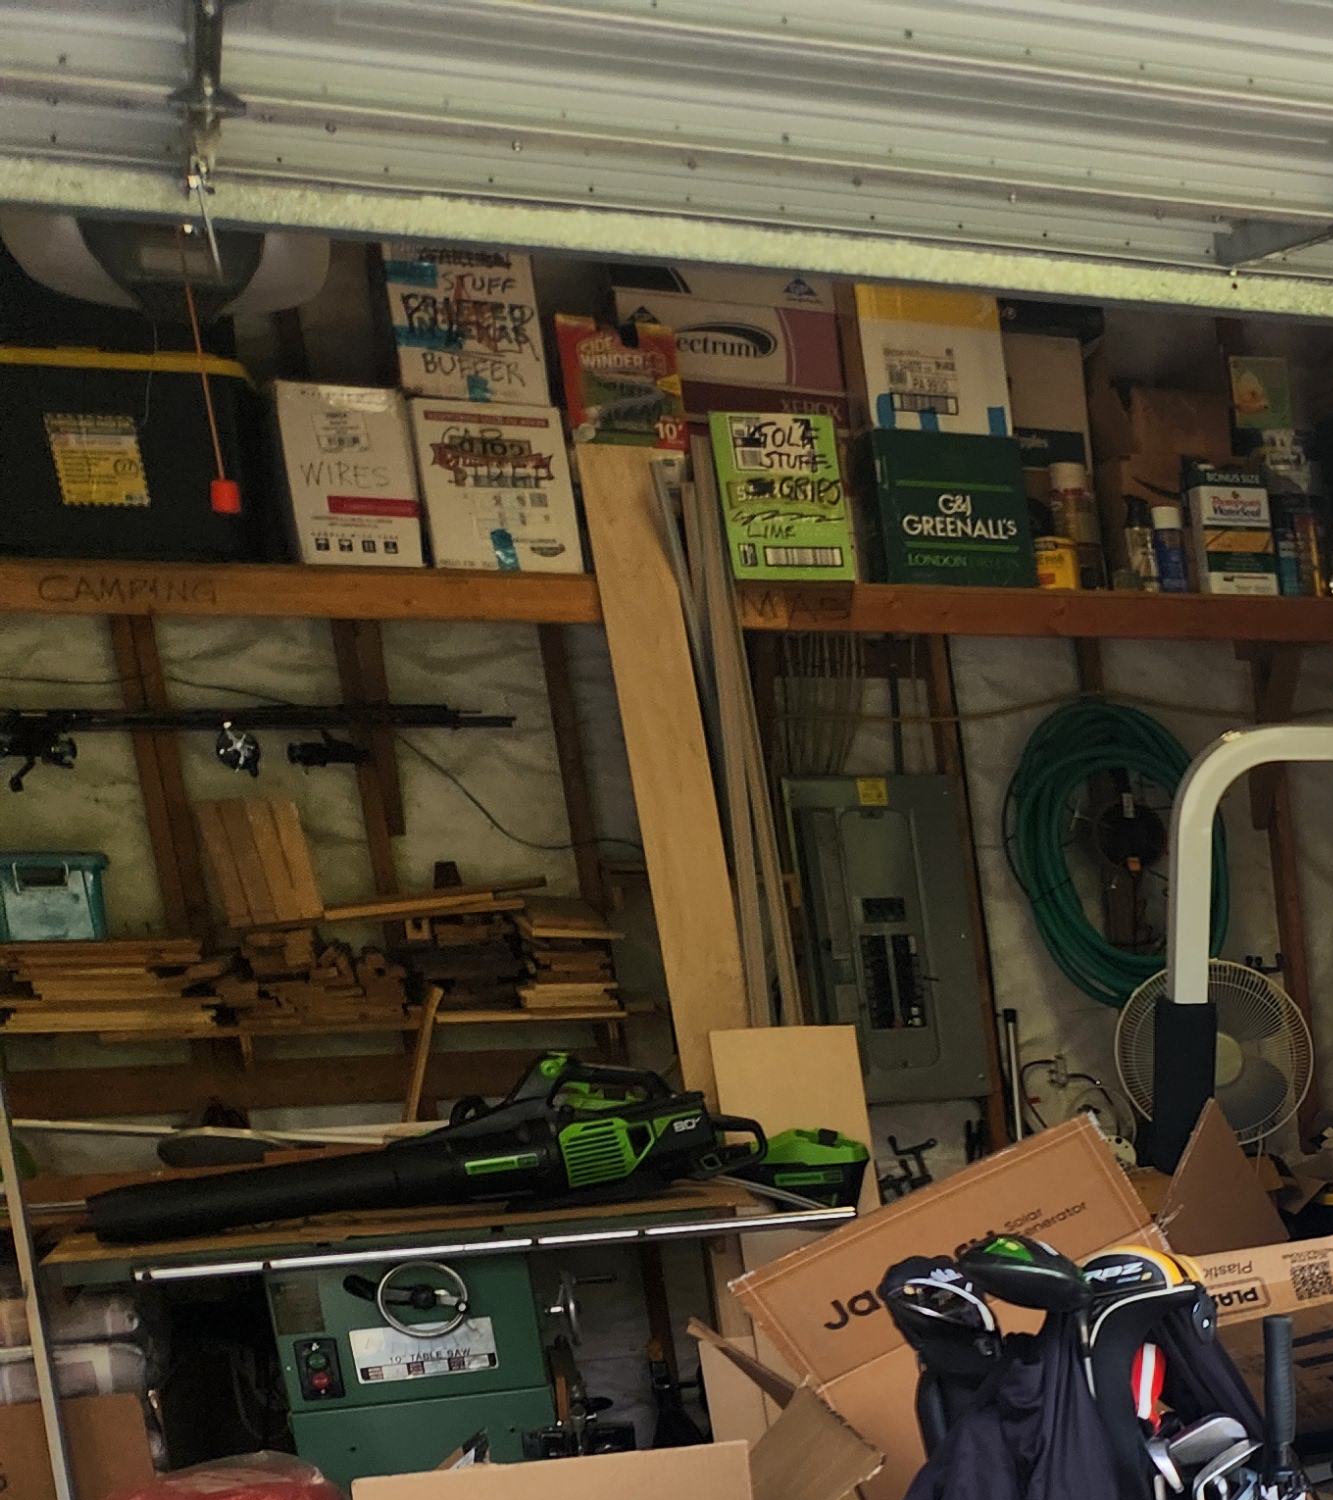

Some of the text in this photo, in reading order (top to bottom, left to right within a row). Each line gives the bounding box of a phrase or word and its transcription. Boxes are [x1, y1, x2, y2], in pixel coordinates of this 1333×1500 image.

[442, 271, 517, 295] STUFF
[677, 335, 760, 359] ectrum
[422, 351, 526, 387] BUFFER
[580, 353, 644, 369] WINDER
[300, 460, 390, 489] WIRES
[1206, 472, 1260, 485] BONUS SIZE
[937, 494, 973, 516] G&J
[747, 525, 797, 541] LIME
[902, 515, 1018, 541] GREENALL'S
[907, 553, 968, 567] LONDON
[37, 574, 218, 605] CAMPING
[1003, 1206, 1044, 1234] Solar
[1015, 1201, 1088, 1239] enerator
[410, 1349, 444, 1363] TABLE
